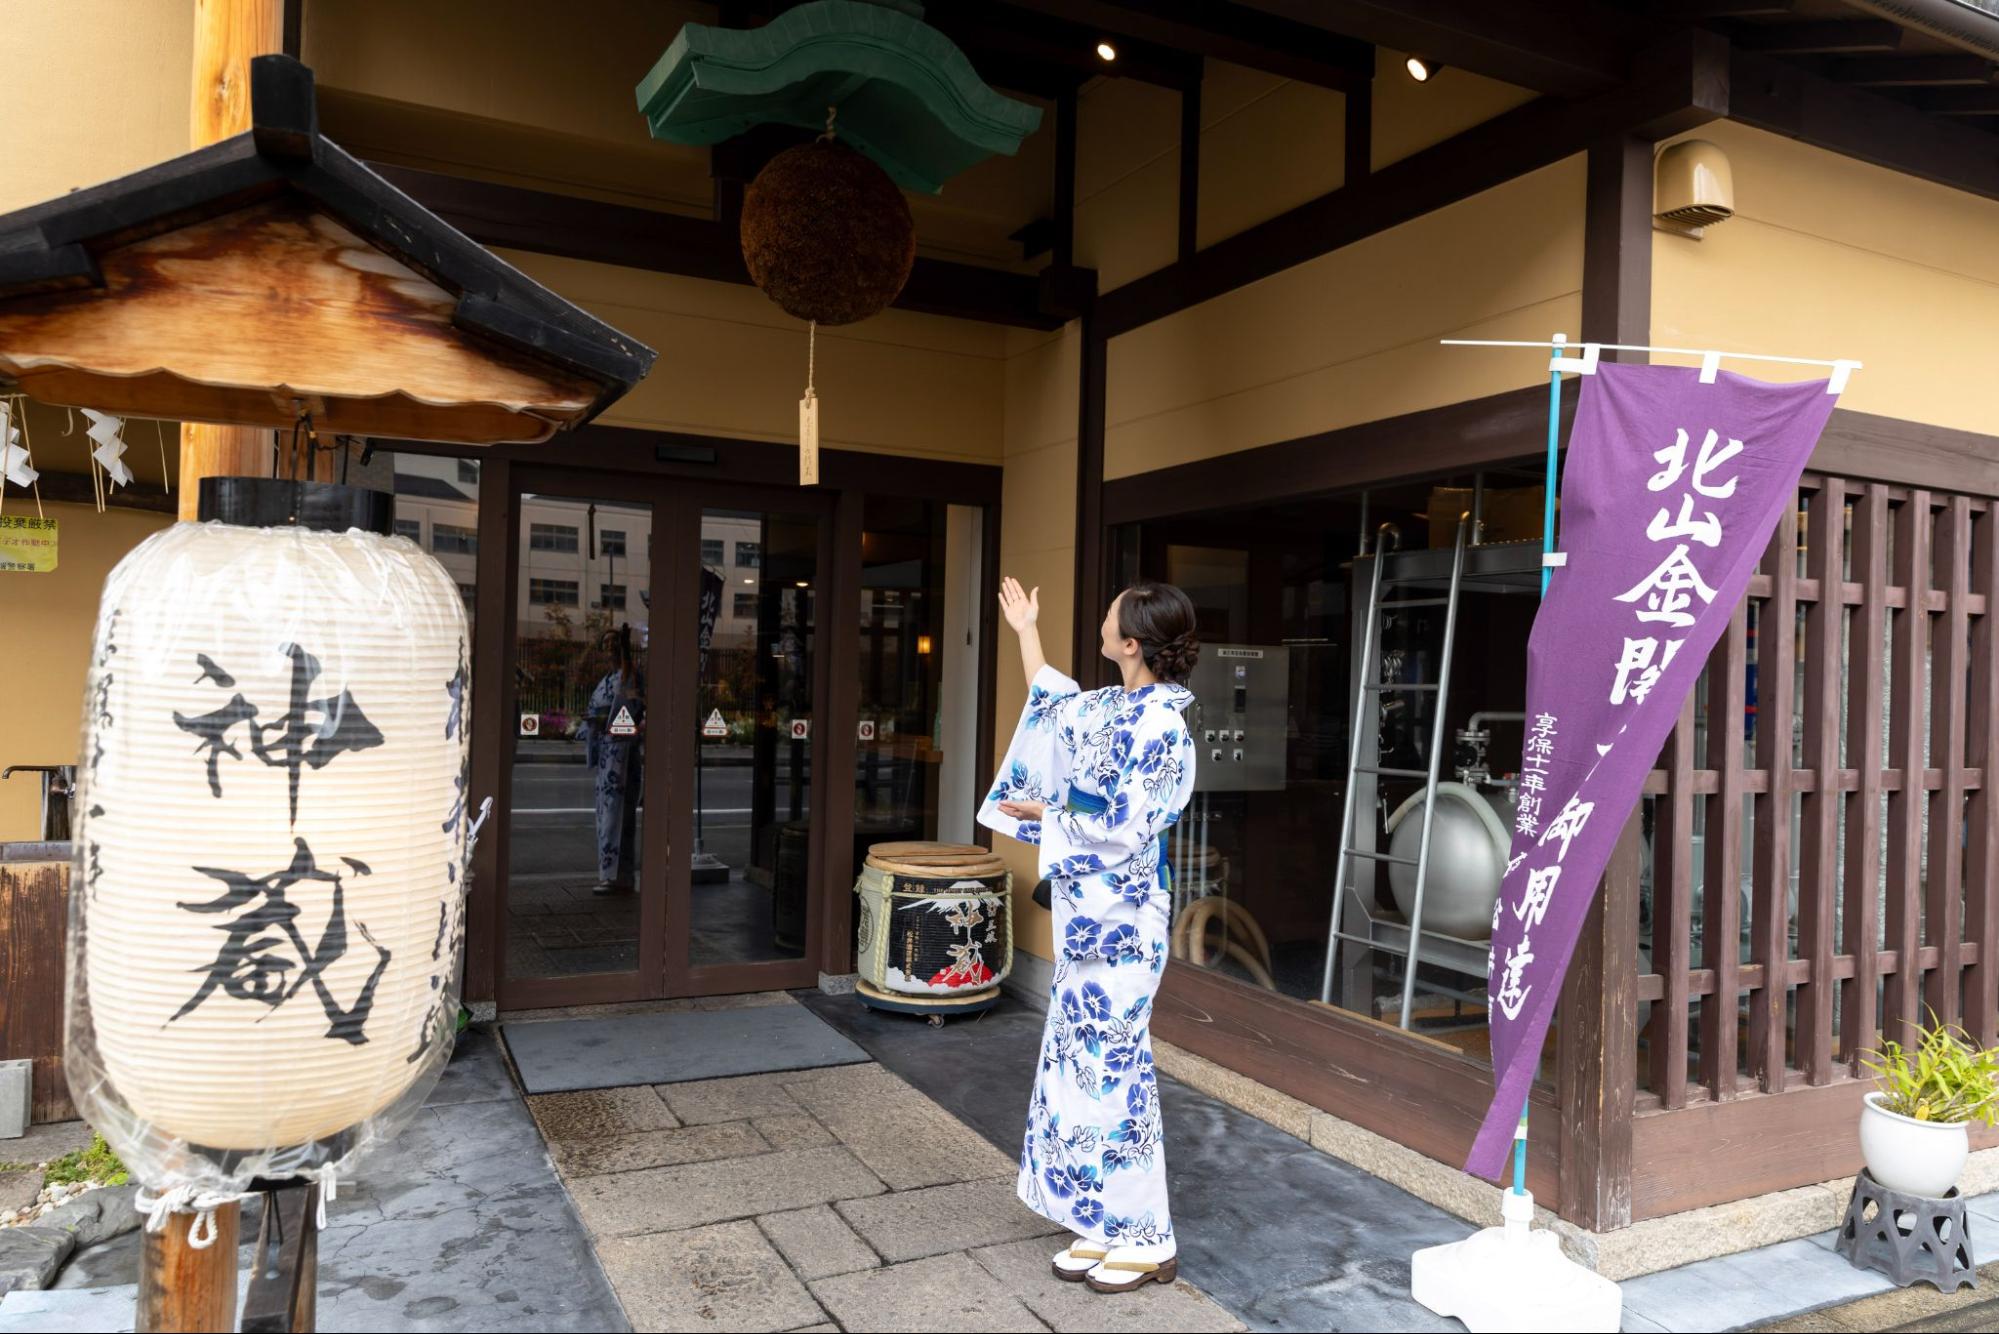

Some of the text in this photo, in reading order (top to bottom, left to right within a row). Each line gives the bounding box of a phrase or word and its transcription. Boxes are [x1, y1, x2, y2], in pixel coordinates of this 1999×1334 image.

[0, 517, 57, 530] 投棄厳禁
[1516, 712, 1558, 837] 享保十一年創業
[161, 641, 391, 1045] 神蔵
